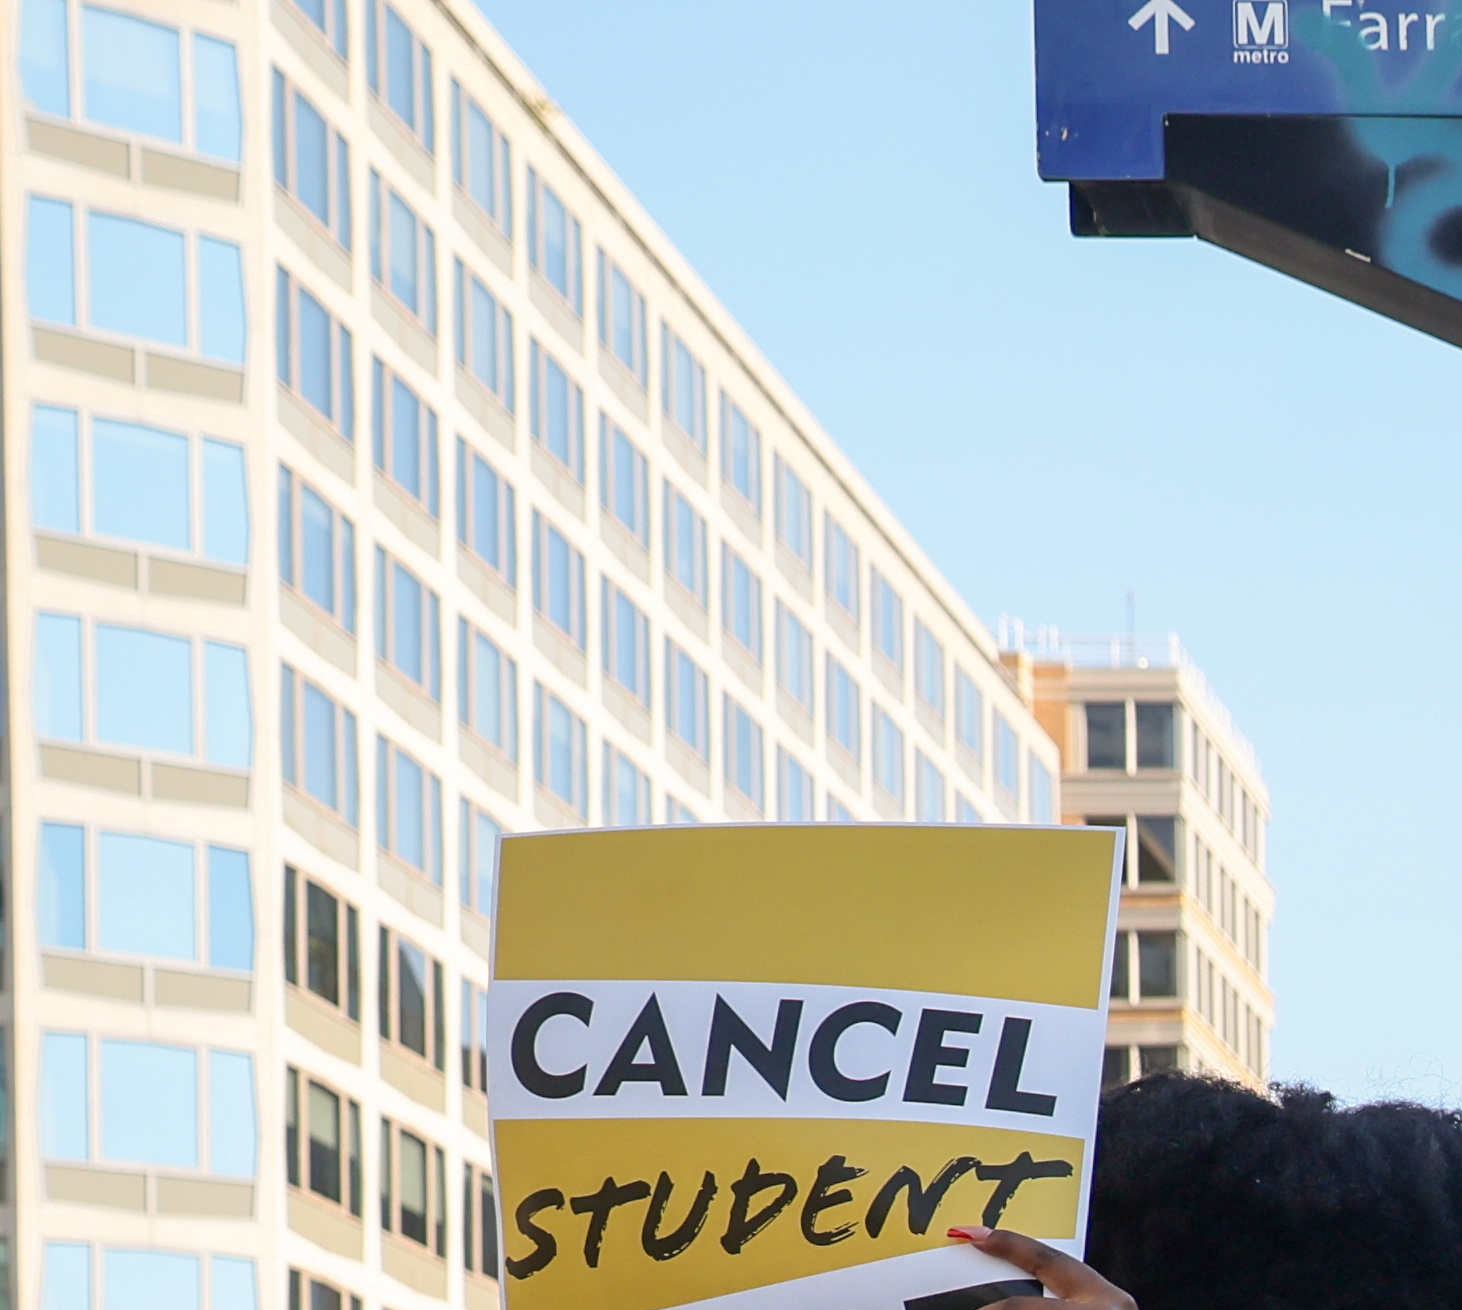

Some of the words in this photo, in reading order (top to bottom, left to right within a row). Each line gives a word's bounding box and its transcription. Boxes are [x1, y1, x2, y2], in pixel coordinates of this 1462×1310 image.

[1233, 49, 1289, 64] metro
[511, 992, 1057, 1117] CANCEL
[505, 1150, 1075, 1281] STUDENT
